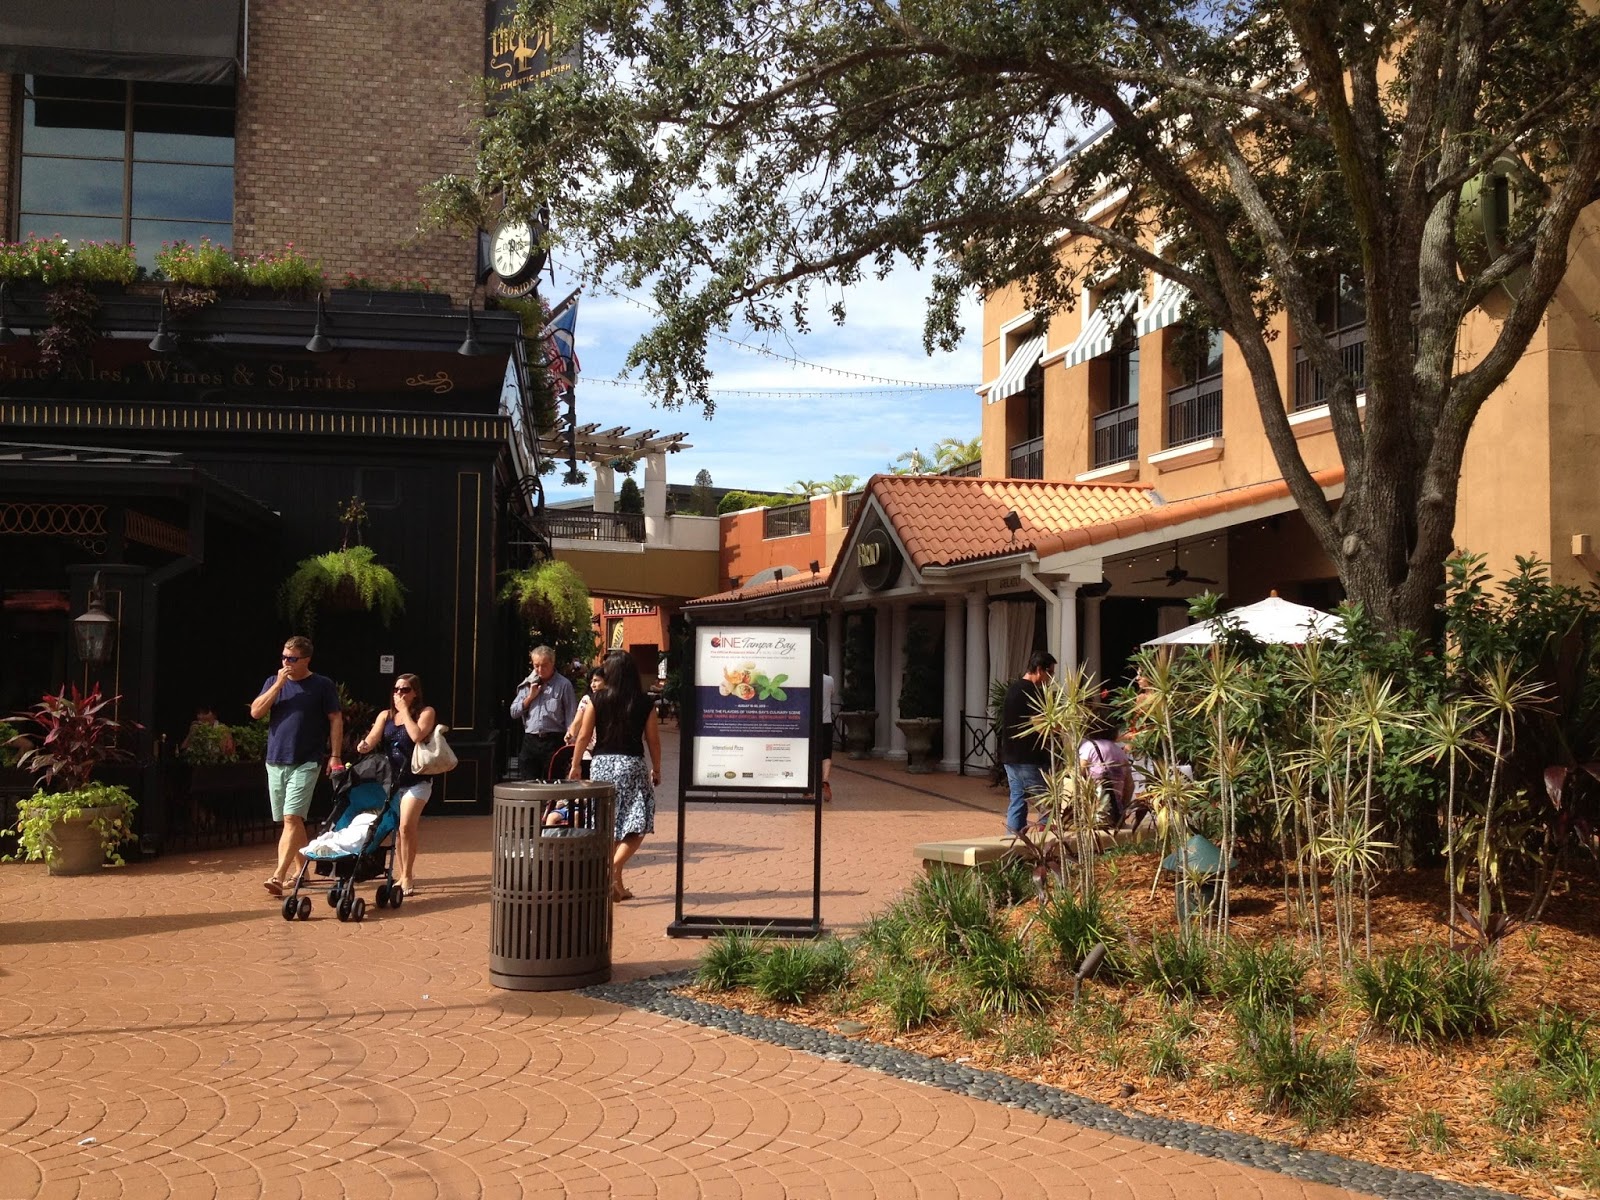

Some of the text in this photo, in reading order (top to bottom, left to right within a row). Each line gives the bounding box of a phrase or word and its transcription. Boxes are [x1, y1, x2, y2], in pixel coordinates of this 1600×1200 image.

[499, 63, 571, 91] UTHENTIC BRITISH
[497, 278, 536, 296] FLORIDA
[144, 360, 223, 384] Wines
[233, 362, 255, 386] &
[268, 364, 356, 391] Spirits
[741, 637, 773, 655] Tampa
[774, 637, 795, 655] Bay
